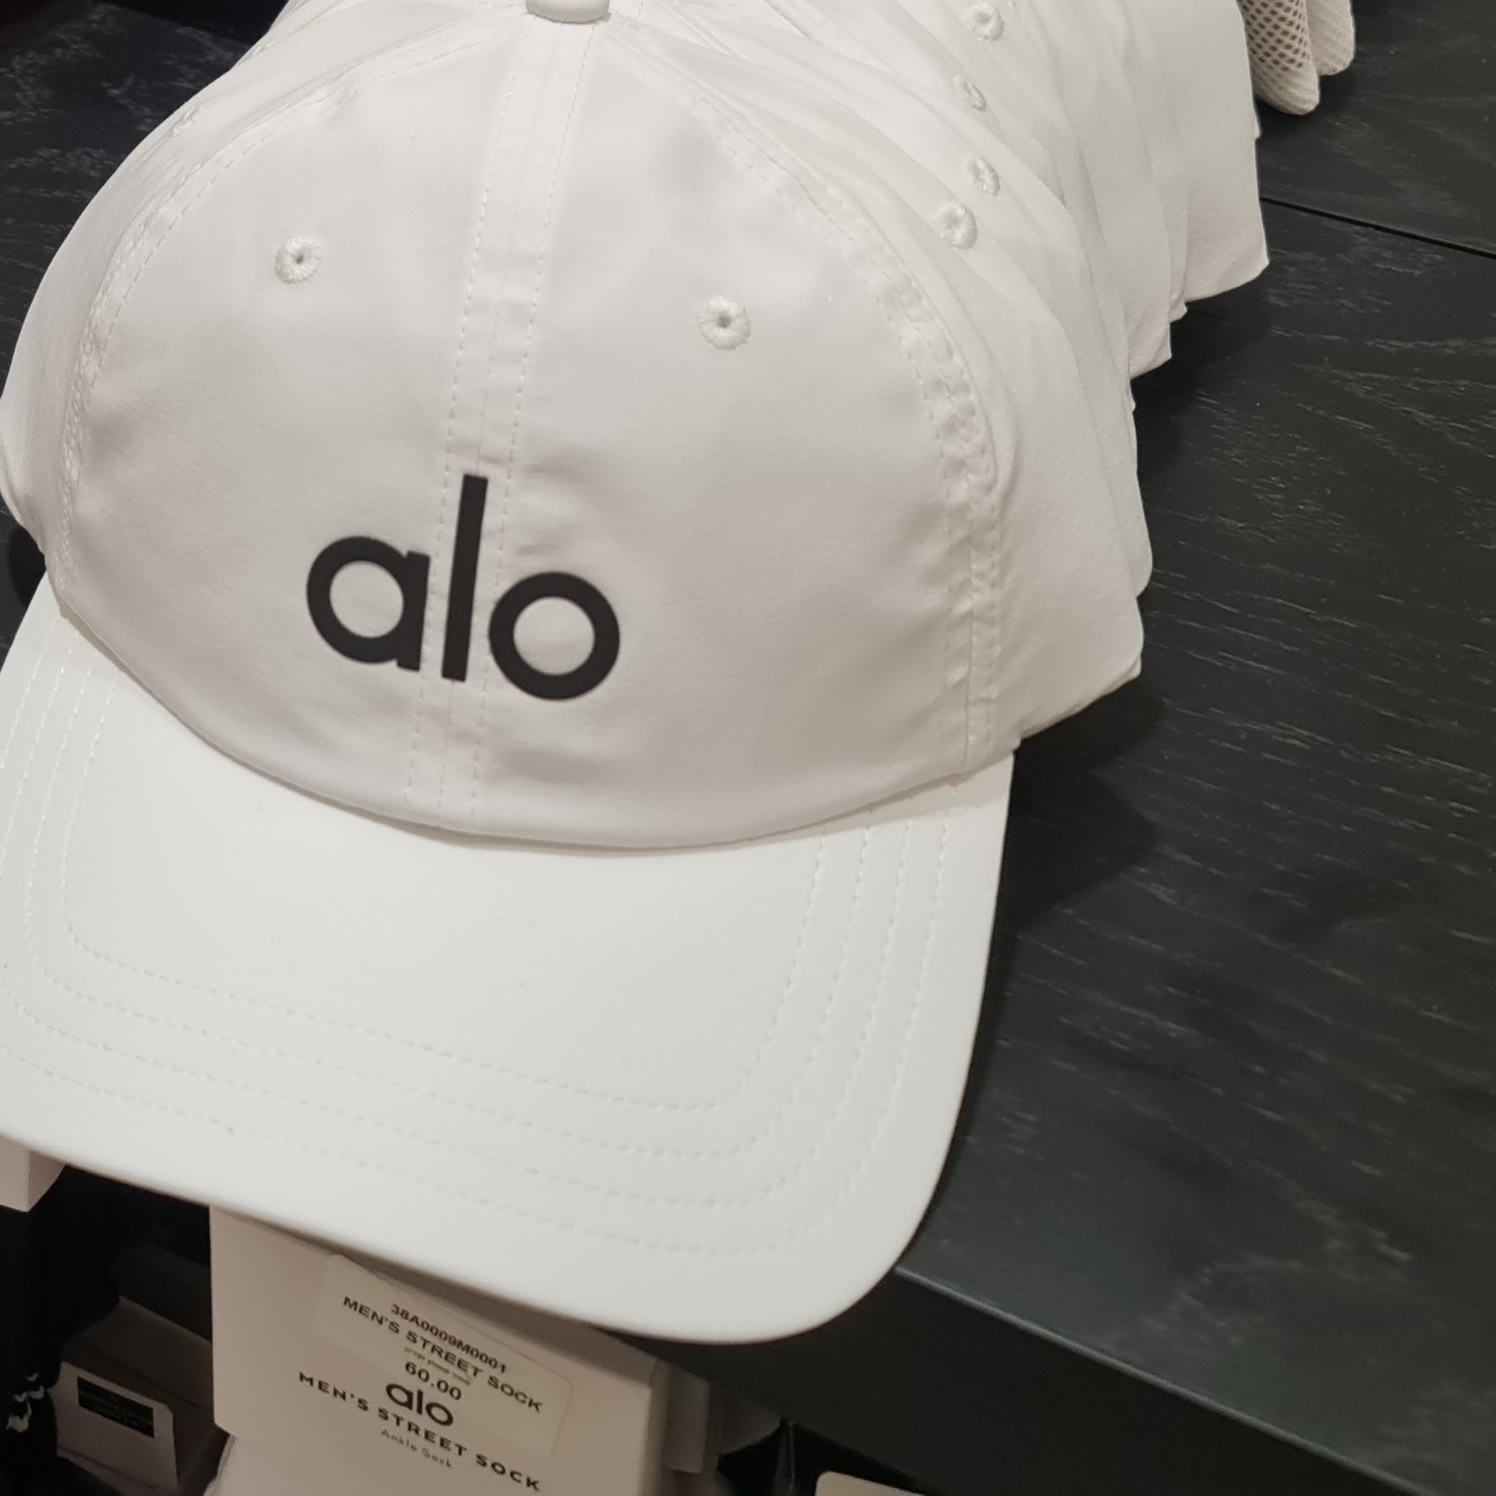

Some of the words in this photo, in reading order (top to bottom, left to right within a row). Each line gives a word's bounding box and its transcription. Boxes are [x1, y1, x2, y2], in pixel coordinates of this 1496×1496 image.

[306, 473, 620, 701] alo
[343, 1295, 401, 1335] MEN'S
[405, 1329, 484, 1378] STREET
[486, 1374, 544, 1413] SOCK
[390, 1303, 508, 1374] 38A0009M0001
[385, 1382, 455, 1427] alo
[405, 1360, 462, 1402] 60.00
[298, 1371, 370, 1412] MEN'S
[377, 1406, 468, 1457] STREET
[475, 1453, 541, 1492] SOCK
[380, 1428, 418, 1453] Ankle
[422, 1447, 453, 1469] Sock
